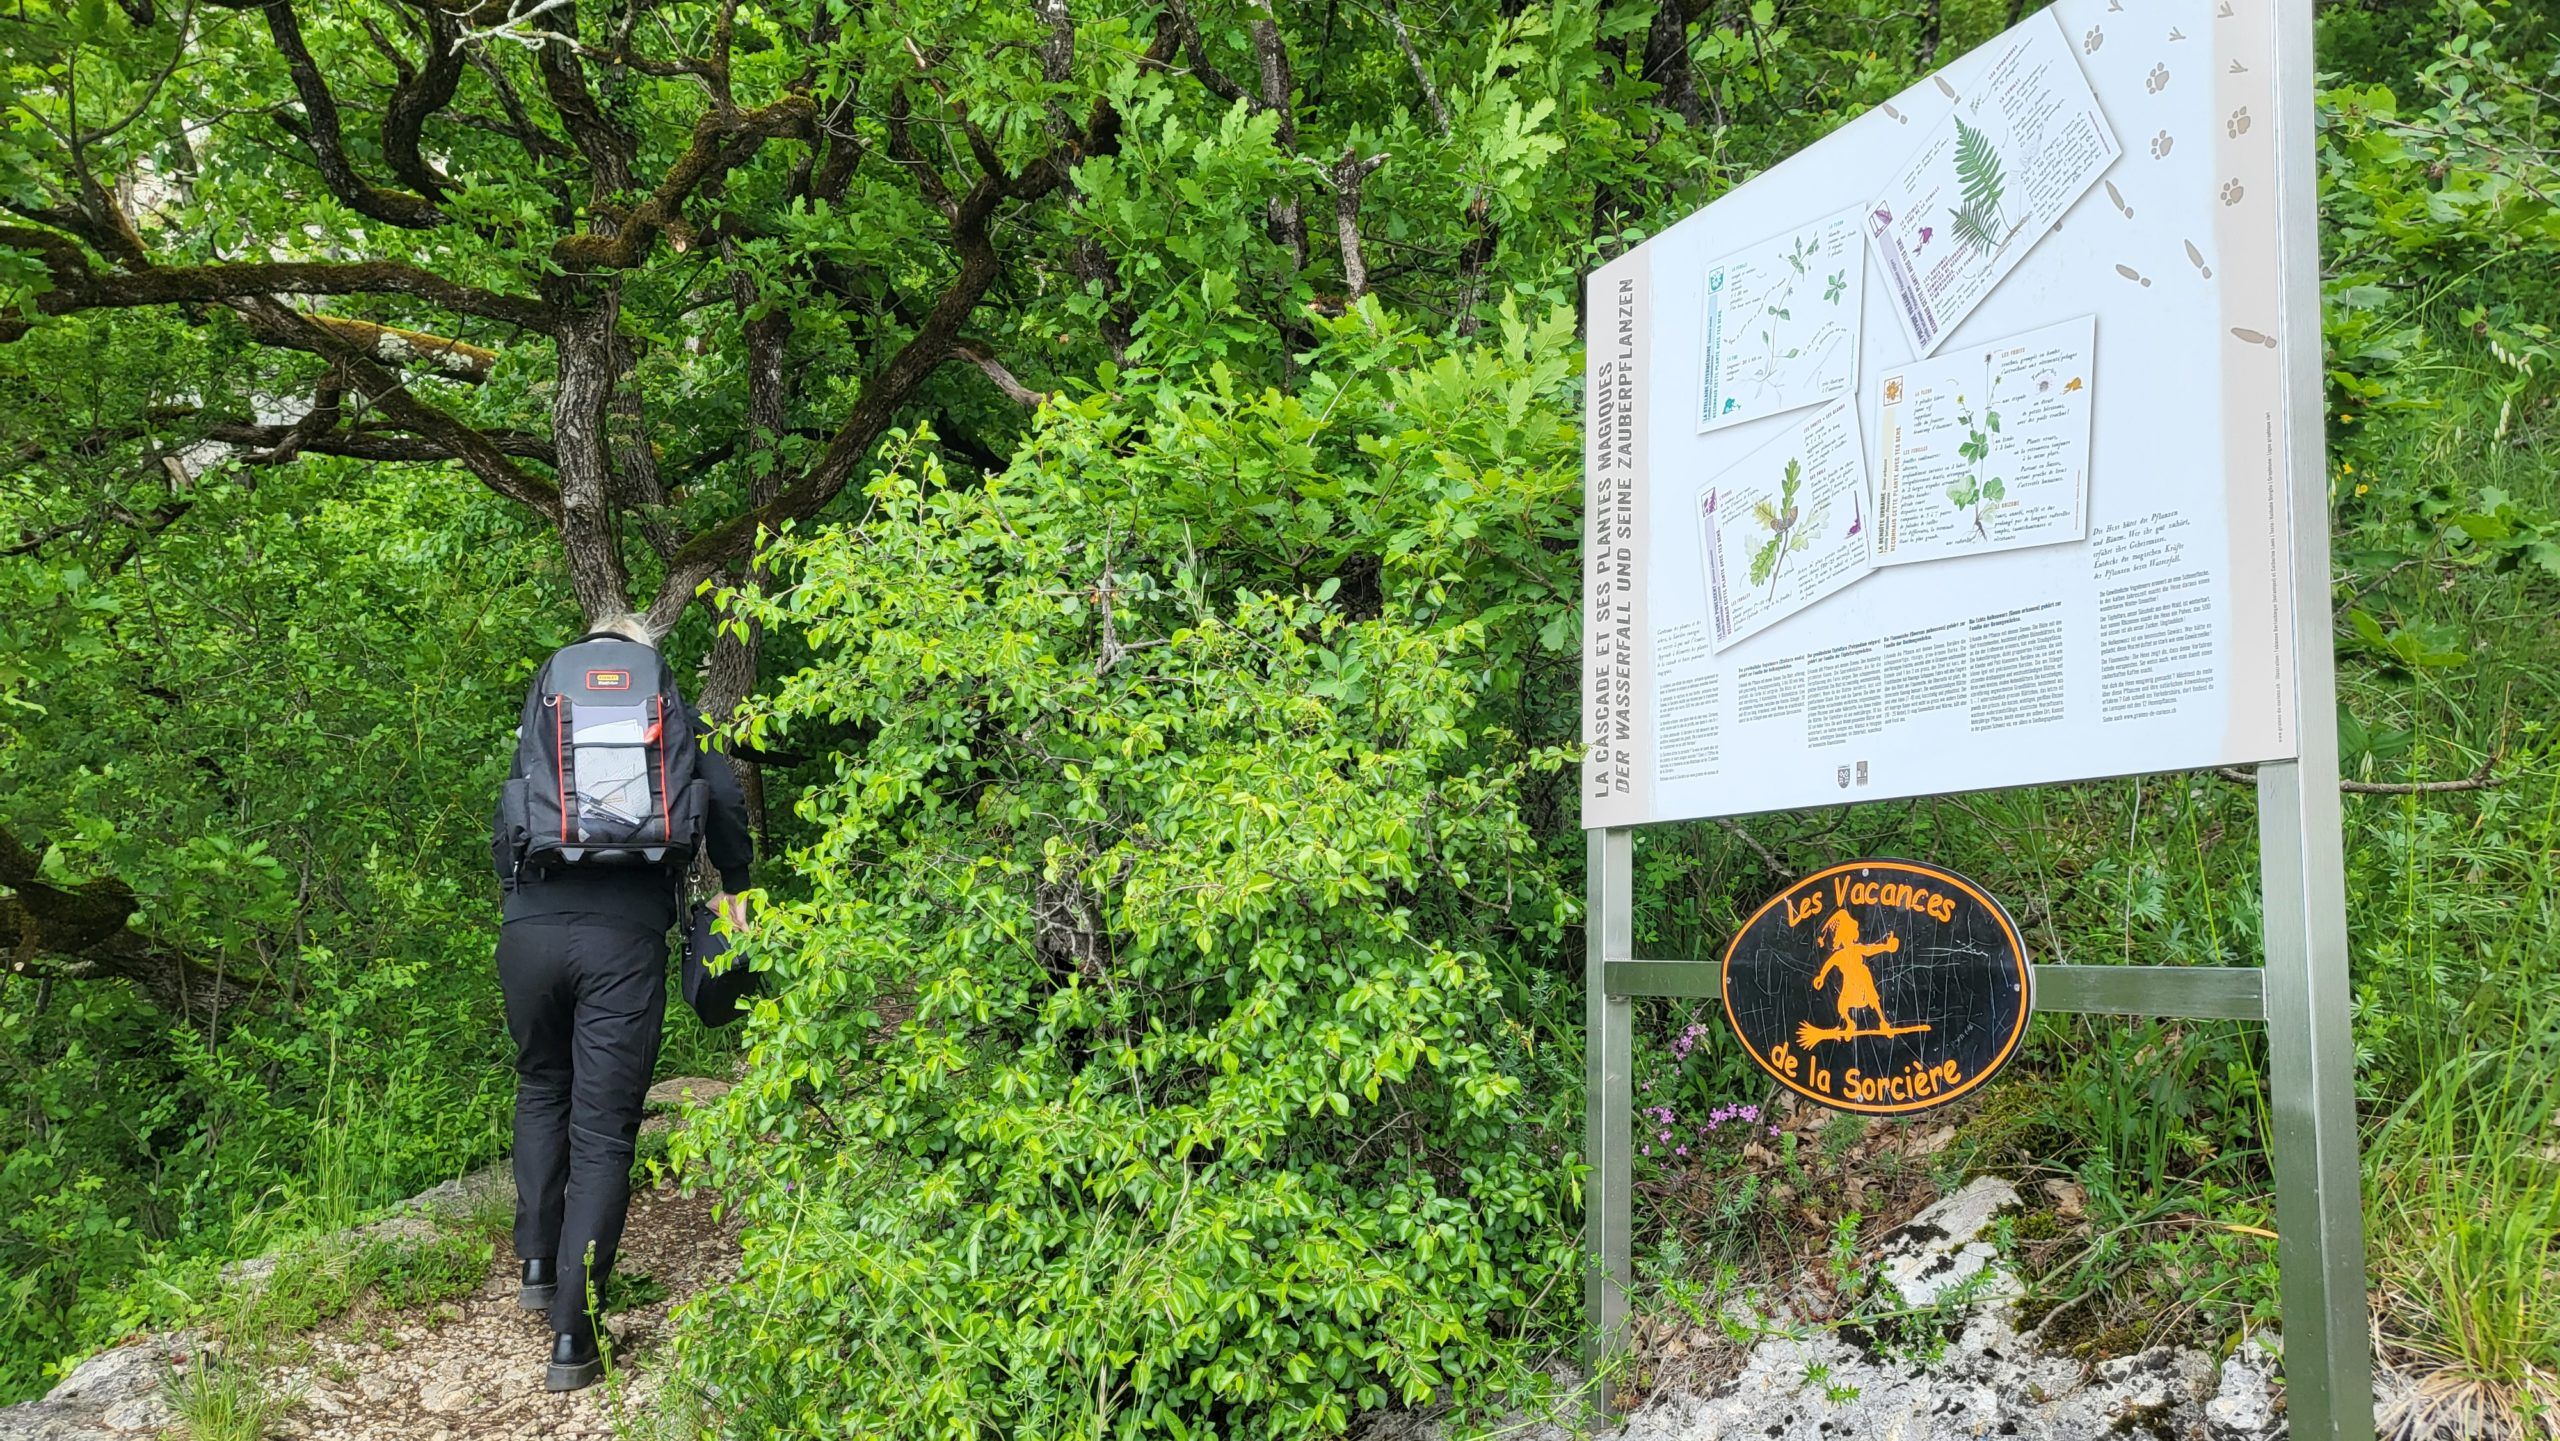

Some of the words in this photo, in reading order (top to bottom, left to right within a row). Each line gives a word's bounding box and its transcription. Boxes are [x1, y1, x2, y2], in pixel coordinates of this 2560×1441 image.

[1617, 278, 1634, 470] ZAUBERPFLANZEN
[1598, 361, 1614, 472] MAGIQUES
[1597, 477, 1612, 575] PLANTES
[1617, 478, 1632, 539] SEINE
[1617, 548, 1631, 591] UND
[1596, 581, 1610, 621] SES
[1596, 632, 1610, 657] ET
[1616, 601, 1631, 741] WASSERFALL
[1595, 664, 1609, 762] CASCADE
[1595, 771, 1608, 798] LA
[1616, 752, 1630, 793] DER
[1785, 891, 1823, 927] Les
[1834, 875, 1956, 923] Vacances
[1771, 1042, 1798, 1078] de
[1810, 1056, 1830, 1094] la
[1843, 1059, 1961, 1101] Sorcière
